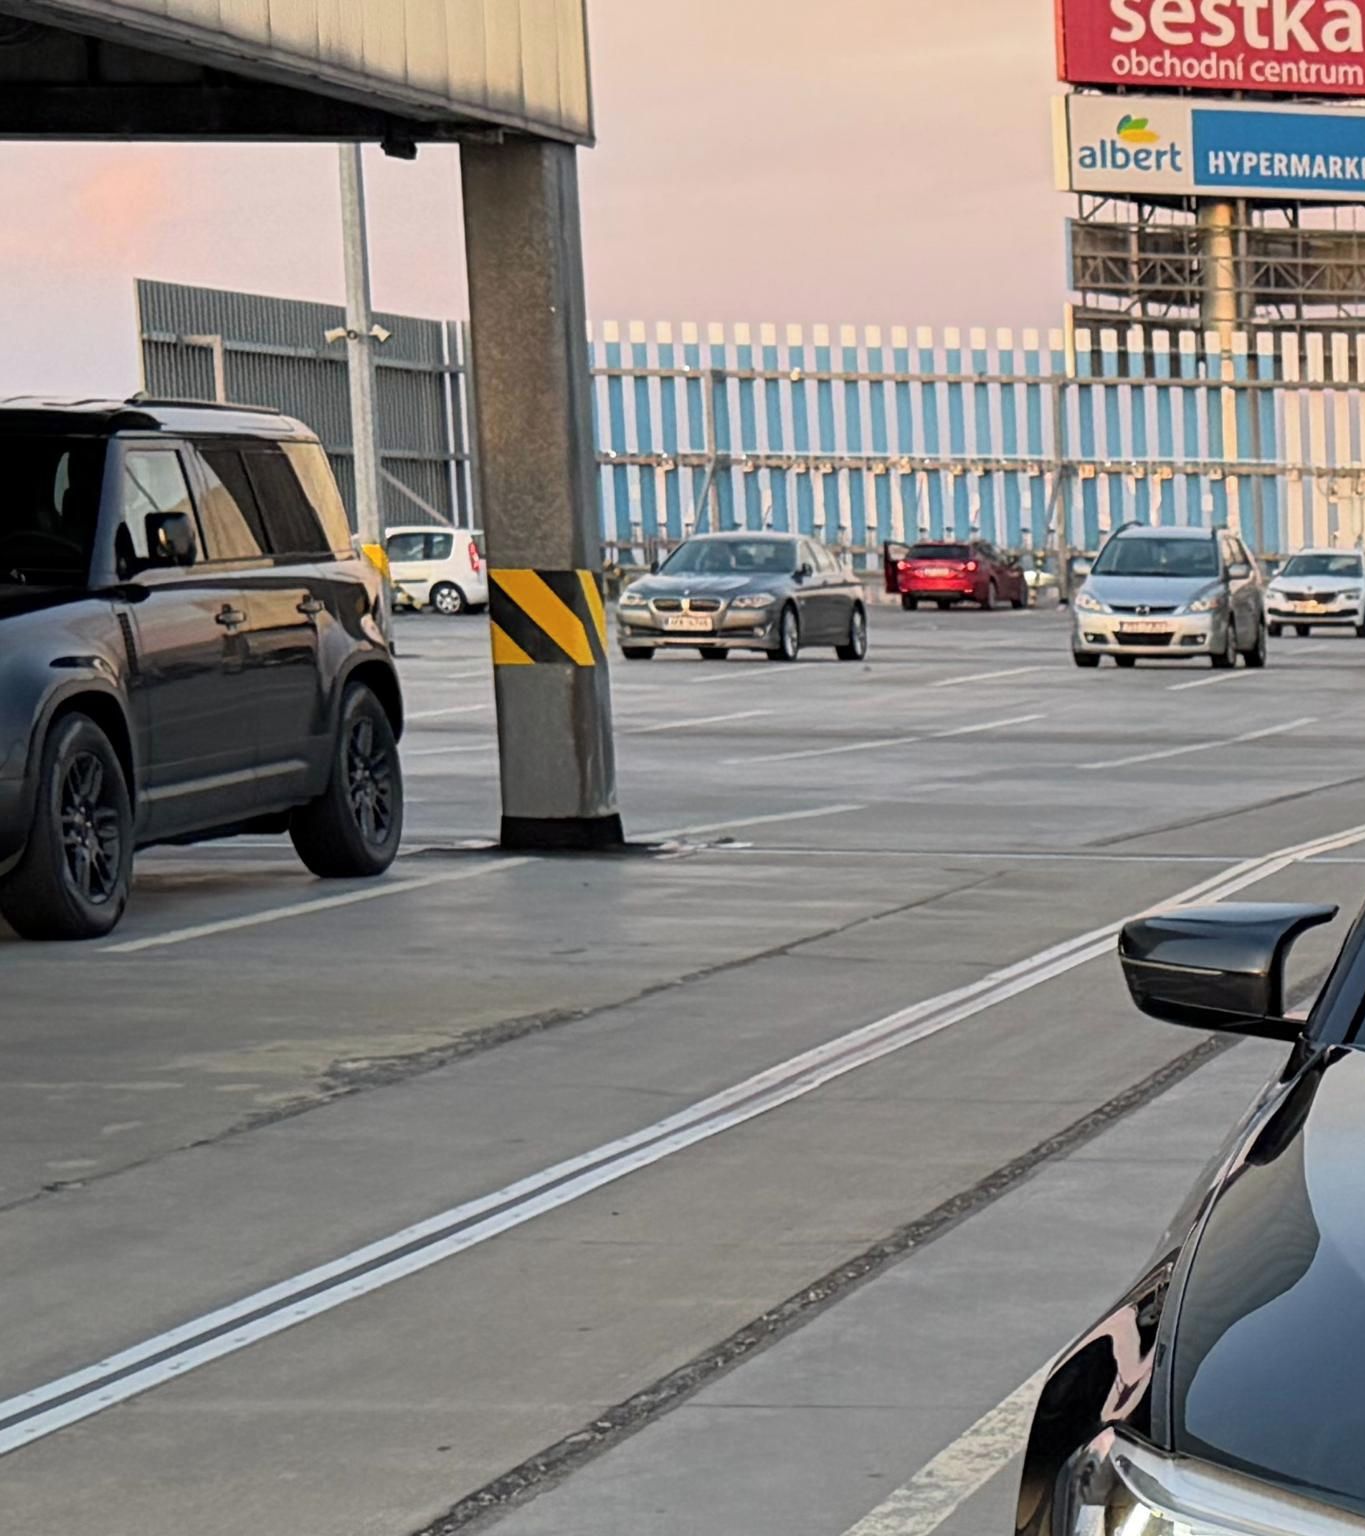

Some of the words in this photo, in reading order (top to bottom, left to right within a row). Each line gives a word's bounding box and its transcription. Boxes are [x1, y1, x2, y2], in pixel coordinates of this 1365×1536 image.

[1111, 47, 1245, 82] obchodní
[1249, 59, 1364, 86] centrum
[1078, 138, 1183, 172] albert
